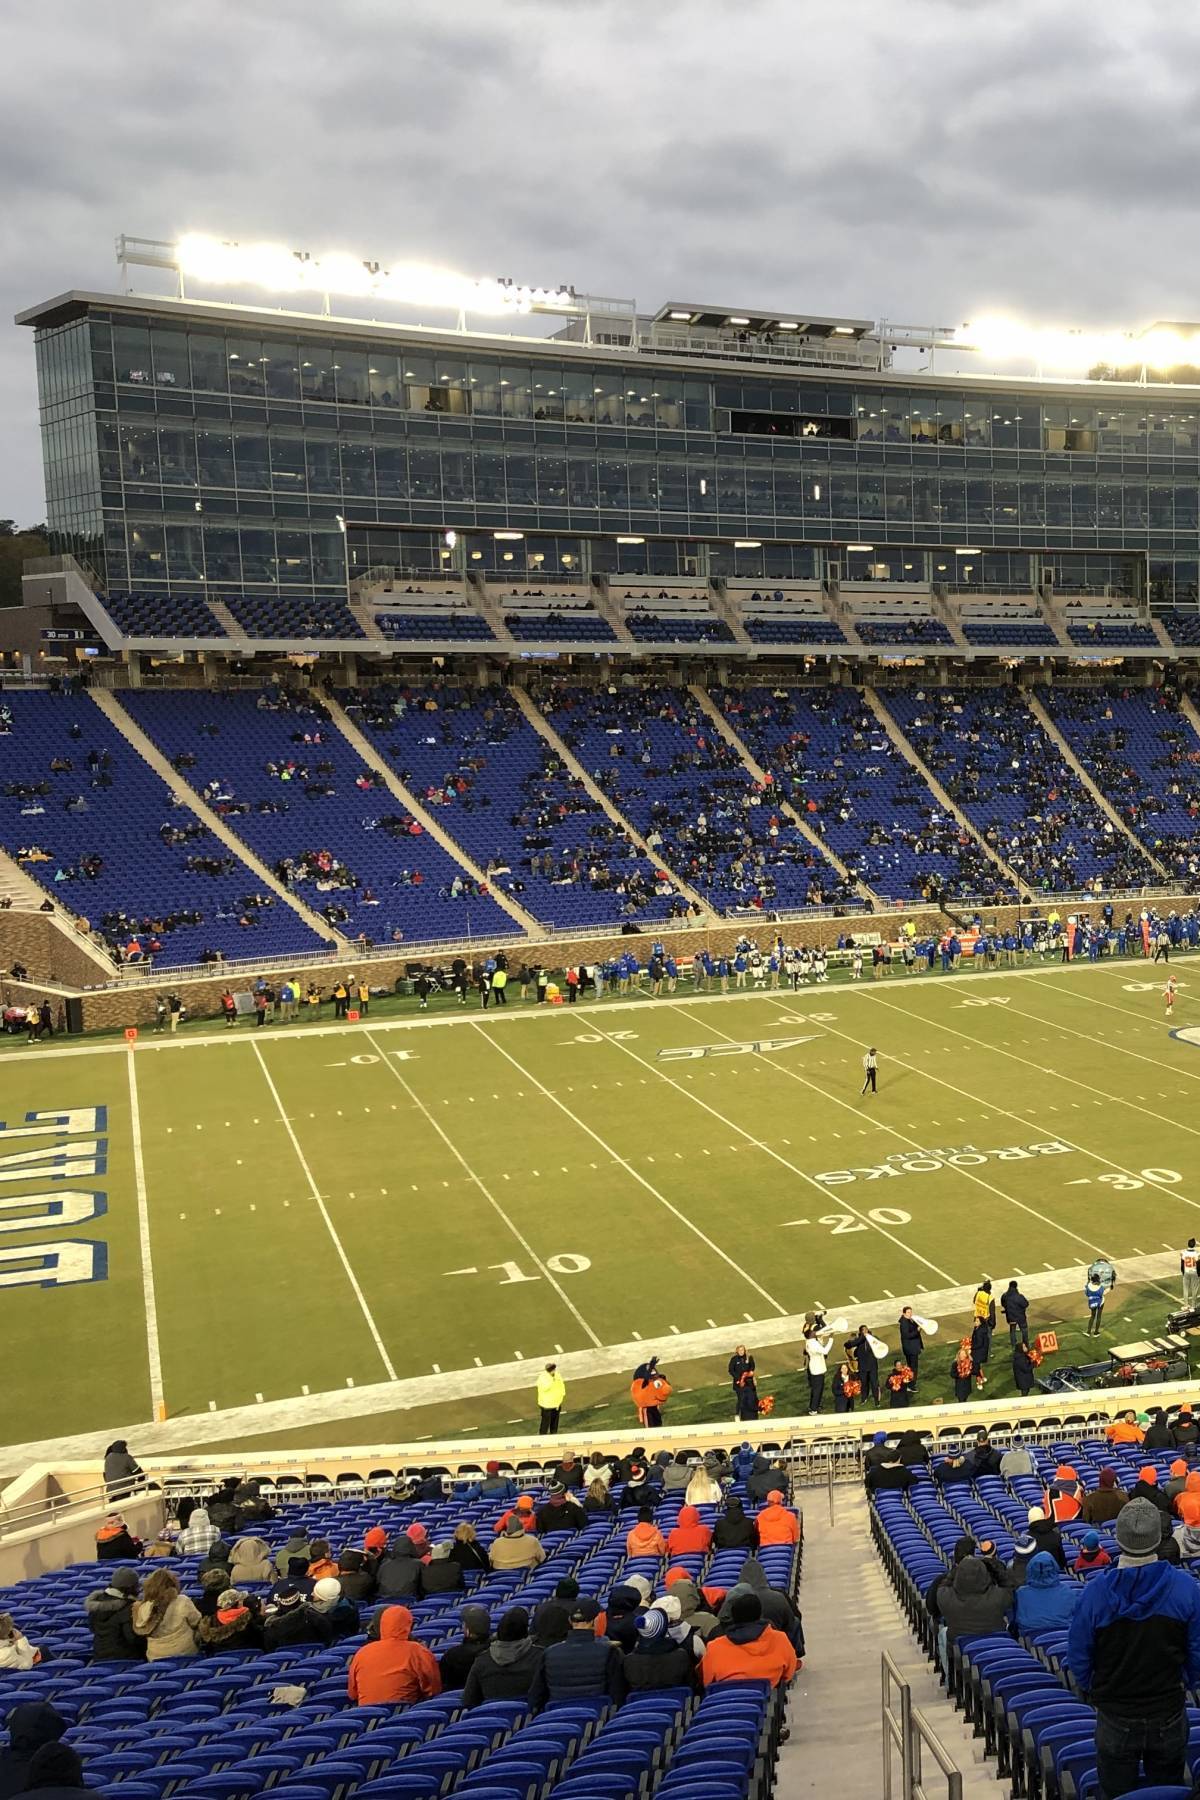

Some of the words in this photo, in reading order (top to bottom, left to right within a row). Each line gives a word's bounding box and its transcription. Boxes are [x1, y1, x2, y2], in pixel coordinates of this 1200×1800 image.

[574, 1029, 640, 1044] 20
[350, 1049, 421, 1065] 10
[812, 1140, 1080, 1186] BROOKS
[1097, 1167, 1184, 1191] 30
[818, 1207, 913, 1235] 20
[487, 1253, 592, 1285] 10
[1183, 1256, 1197, 1269] 21
[1041, 1333, 1056, 1348] 20
